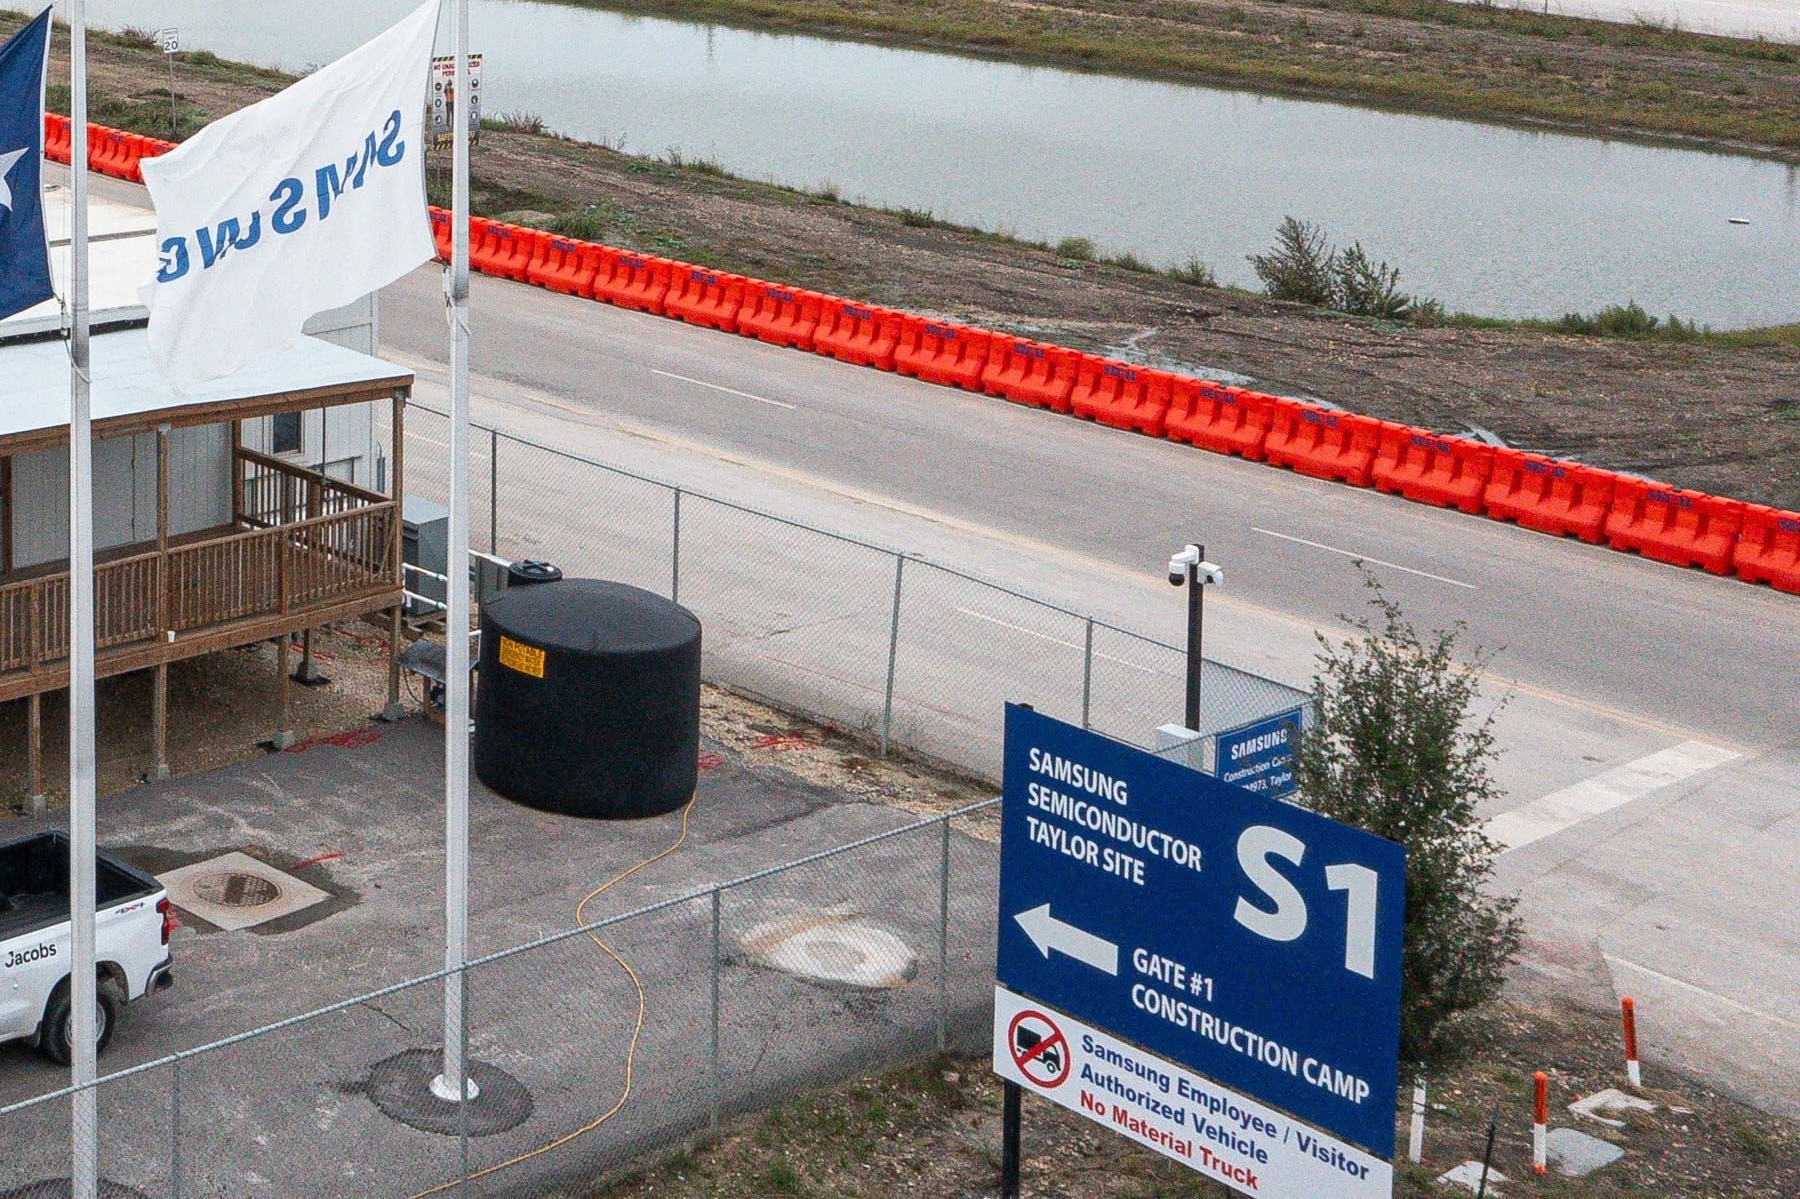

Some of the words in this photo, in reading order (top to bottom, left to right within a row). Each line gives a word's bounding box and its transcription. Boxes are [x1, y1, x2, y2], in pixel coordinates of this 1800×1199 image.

[164, 40, 178, 51] 20
[1029, 747, 1128, 806] SAMSUNG
[1231, 729, 1288, 760] SAMSUNG
[1026, 816, 1099, 867] TAYLOR
[1103, 848, 1145, 886] SITE
[1028, 782, 1202, 873] SEMICONDUCTOR
[1234, 825, 1378, 980] S1
[4, 942, 57, 968] Jacobs
[1132, 948, 1185, 989] GATE
[1191, 972, 1214, 1002] #1
[1131, 983, 1298, 1077] CONSTRUCTION
[1302, 1057, 1370, 1105] CAMP
[1080, 1063, 1185, 1126] Authorized
[1192, 1113, 1269, 1165] Vehicle
[1080, 1089, 1106, 1117] No
[1112, 1105, 1193, 1159] Material
[1199, 1145, 1258, 1190] Truck
[1082, 1034, 1170, 1093] Samsung
[1177, 1076, 1277, 1138] Employee
[1283, 1126, 1290, 1144] /
[1296, 1130, 1370, 1181] Visitor
